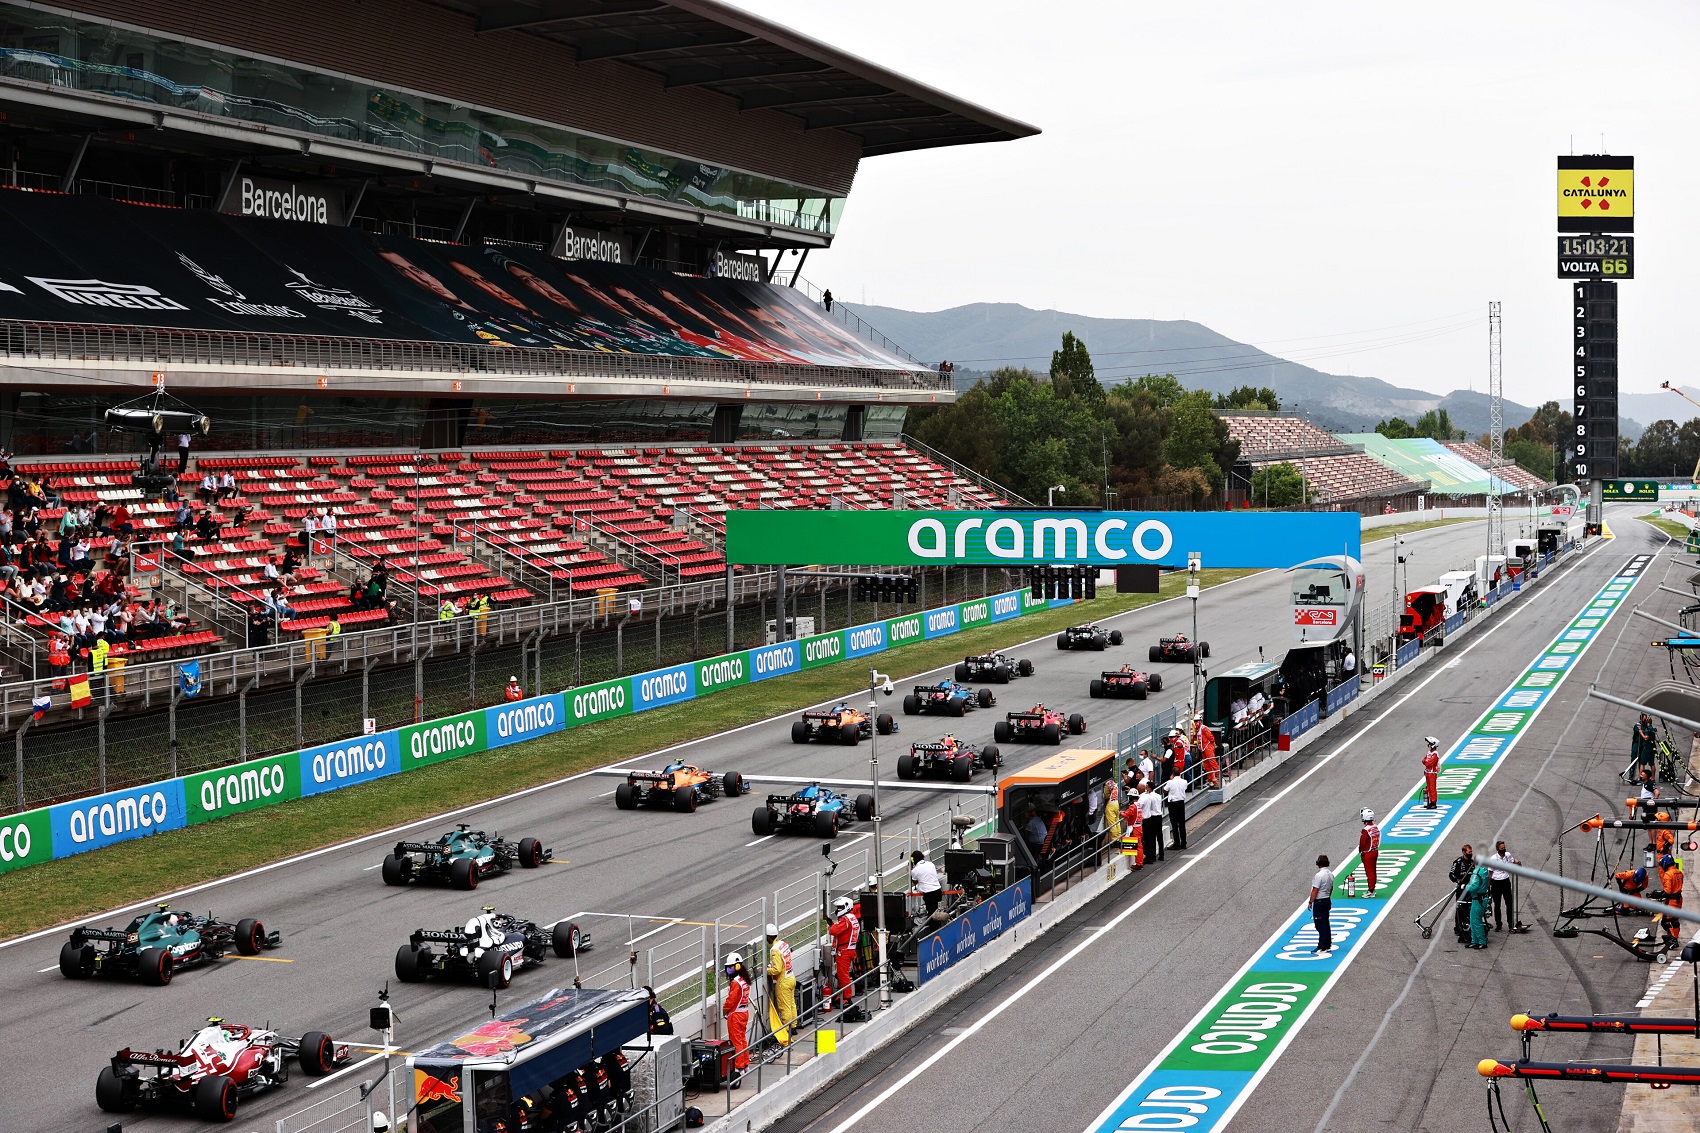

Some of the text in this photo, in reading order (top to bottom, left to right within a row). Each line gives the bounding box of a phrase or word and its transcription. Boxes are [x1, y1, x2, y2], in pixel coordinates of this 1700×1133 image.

[242, 177, 327, 224] Barcelona
[1563, 189, 1626, 197] CATALUNYA
[565, 227, 621, 264] Barcelona
[1563, 239, 1628, 255] 15:03:21
[717, 251, 760, 283] Barcelona
[1562, 259, 1627, 274] VOLTA 66
[25, 276, 190, 311] PIRELLI
[1577, 288, 1583, 298] 1
[1577, 307, 1584, 318] 2
[1577, 327, 1584, 337] 3
[1576, 347, 1585, 357] 4
[1577, 366, 1585, 377] 5
[1577, 386, 1585, 397] 6
[1577, 405, 1584, 416] 7
[1577, 425, 1585, 436] 8
[1577, 444, 1585, 455] 9
[1576, 464, 1586, 475] 10
[907, 518, 1173, 560] aramco
[963, 602, 987, 623] aramco
[994, 595, 1018, 614] aramco
[891, 618, 920, 641] aramco
[929, 610, 955, 632] aramco
[806, 637, 840, 662] aramco
[850, 627, 882, 651] aramco
[756, 646, 794, 674] aramco
[701, 658, 743, 687] aramco
[641, 670, 687, 702] aramco
[574, 685, 625, 719] aramco
[497, 701, 555, 737] aramco
[411, 719, 475, 759] aramco
[1455, 737, 1505, 760] aramco
[312, 740, 386, 783] aramco
[200, 763, 285, 811] aramco
[70, 790, 167, 843] aramco
[421, 931, 467, 940] HONDA
[1190, 982, 1308, 1055] aramco
[150, 1055, 177, 1063] Romeo
